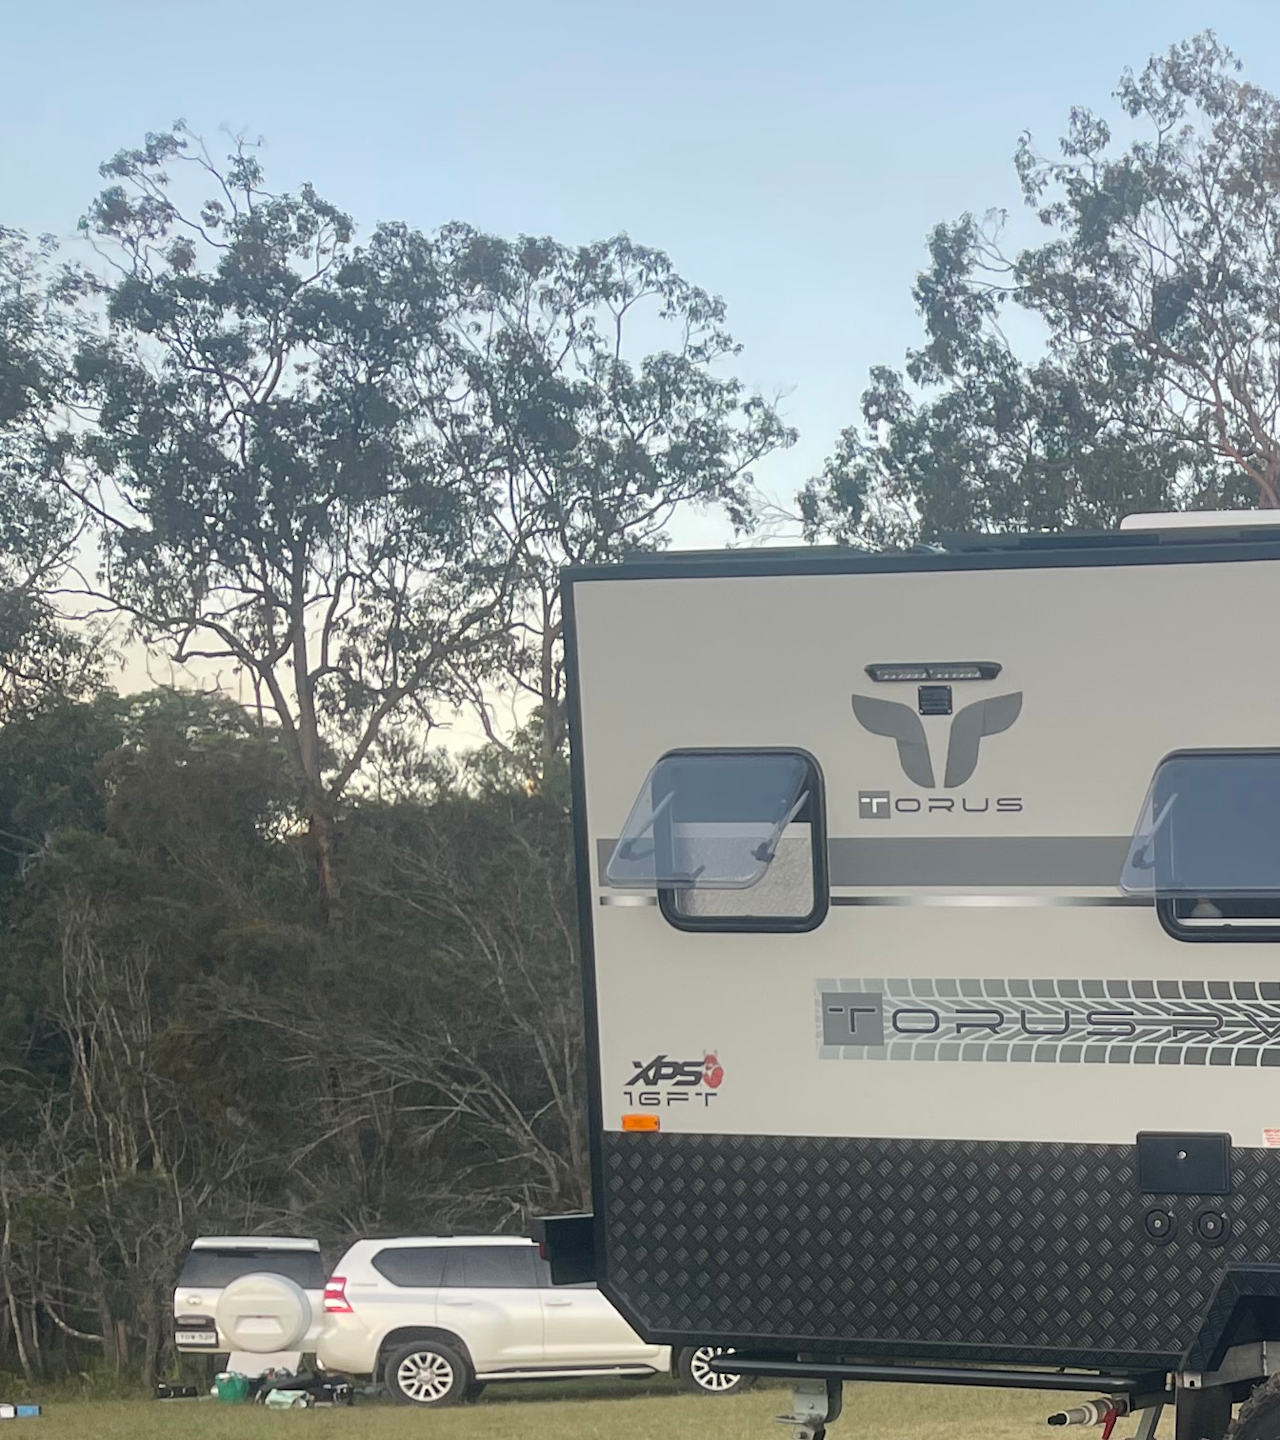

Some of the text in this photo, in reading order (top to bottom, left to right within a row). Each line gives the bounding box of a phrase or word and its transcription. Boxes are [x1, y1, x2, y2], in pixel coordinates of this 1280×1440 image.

[860, 795, 1024, 815] TORUS
[827, 1006, 1137, 1037] TORUS
[624, 1054, 706, 1086] XPS
[623, 1091, 718, 1107] 16FT
